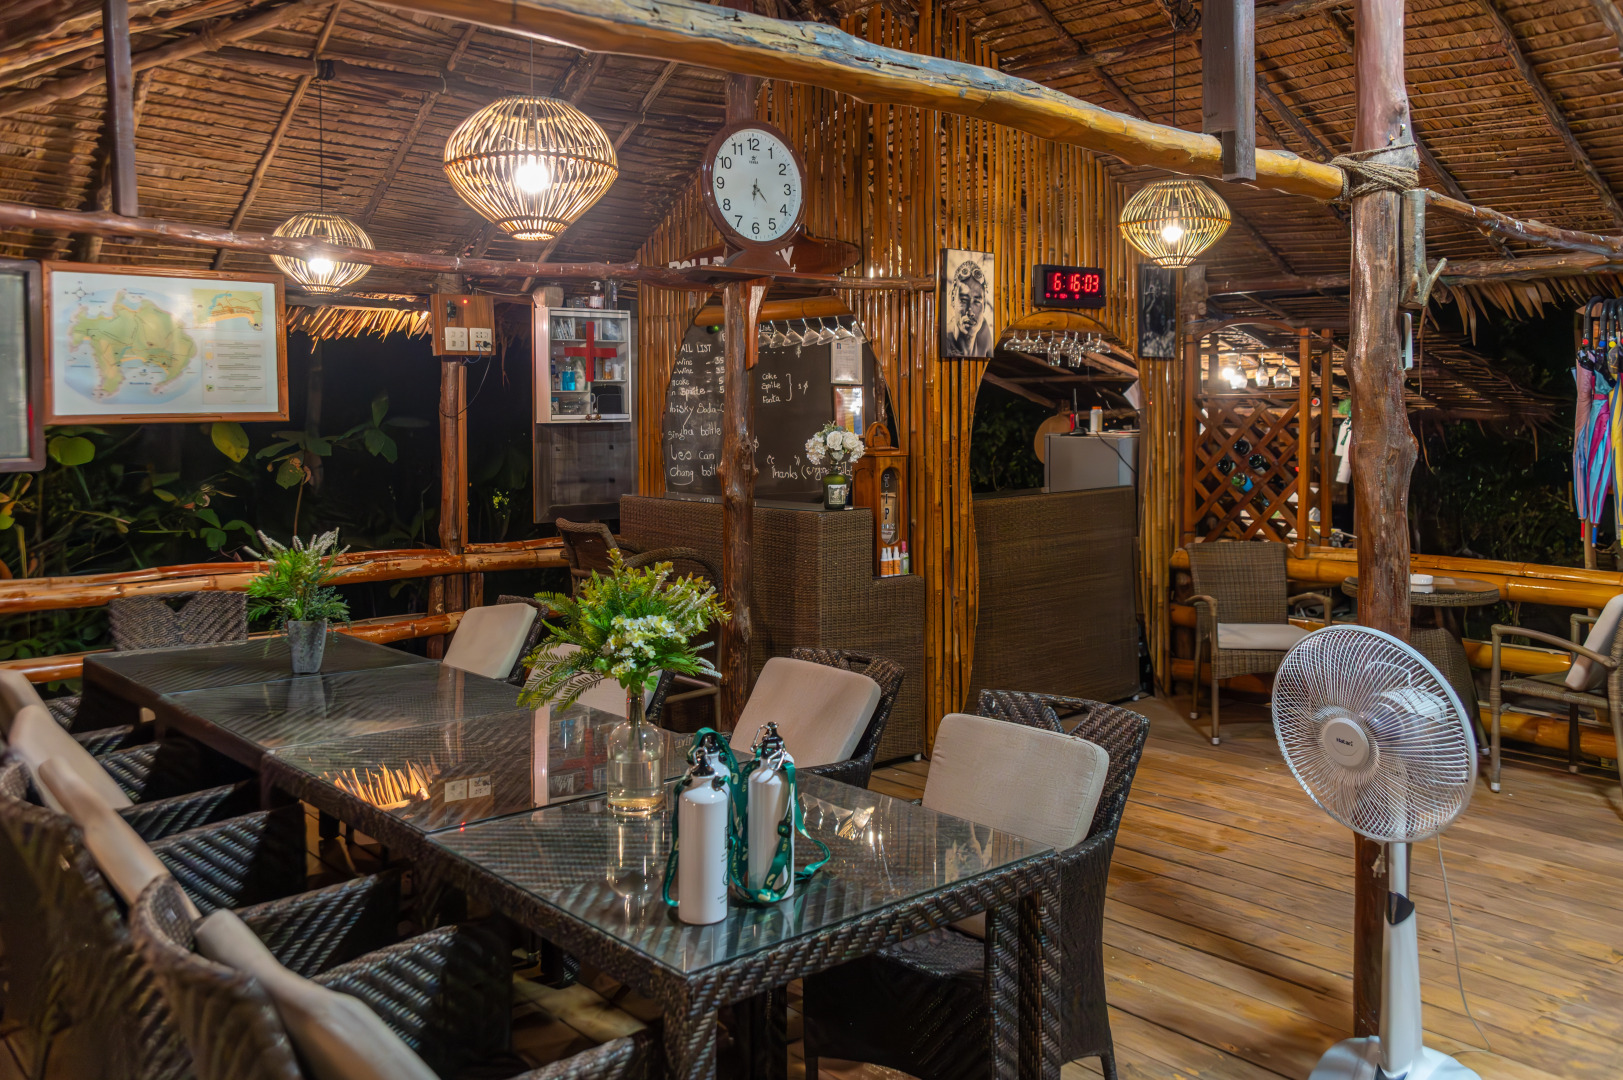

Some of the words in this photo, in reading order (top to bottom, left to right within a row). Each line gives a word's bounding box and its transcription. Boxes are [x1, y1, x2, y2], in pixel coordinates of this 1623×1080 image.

[731, 142, 743, 155] 11
[746, 137, 760, 151] 12
[767, 147, 773, 159] 1
[719, 156, 732, 169] 10
[778, 163, 787, 176] 2
[716, 176, 725, 189] 9
[783, 183, 792, 196] 3
[722, 198, 731, 211] 8
[779, 204, 788, 217] 4
[734, 214, 743, 228] 7
[768, 217, 777, 231] 5
[751, 222, 760, 235] 6
[696, 343, 711, 353] LIST
[700, 422, 722, 437] bottle
